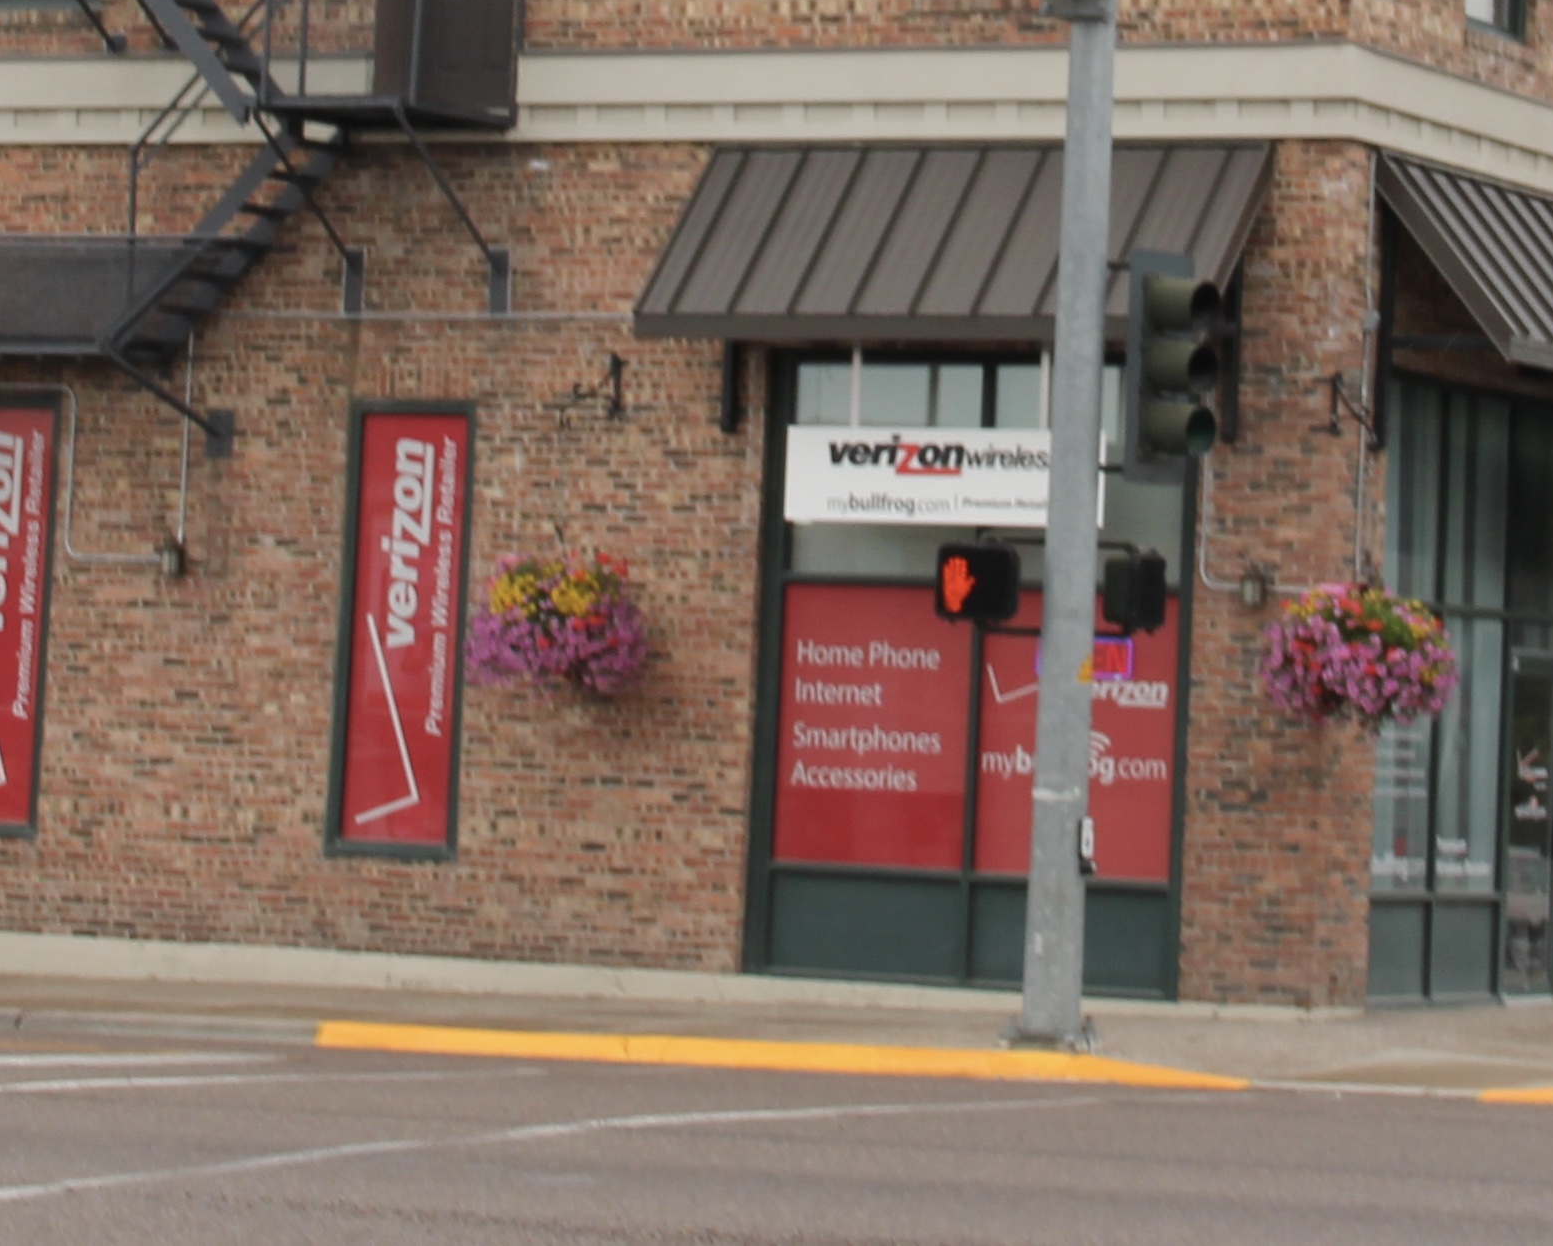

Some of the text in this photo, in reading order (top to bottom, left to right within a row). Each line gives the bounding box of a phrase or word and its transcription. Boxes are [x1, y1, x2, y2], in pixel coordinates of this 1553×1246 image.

[827, 434, 1050, 476] verizonwireles
[381, 437, 435, 649] verizon
[12, 428, 45, 721] Premium Wireless Retailer
[424, 435, 457, 738] Premium Wireless Retailer
[797, 638, 941, 671] Home Phone
[795, 676, 882, 707] Internet
[793, 721, 942, 757] Smartphones
[789, 758, 918, 792] Accessories
